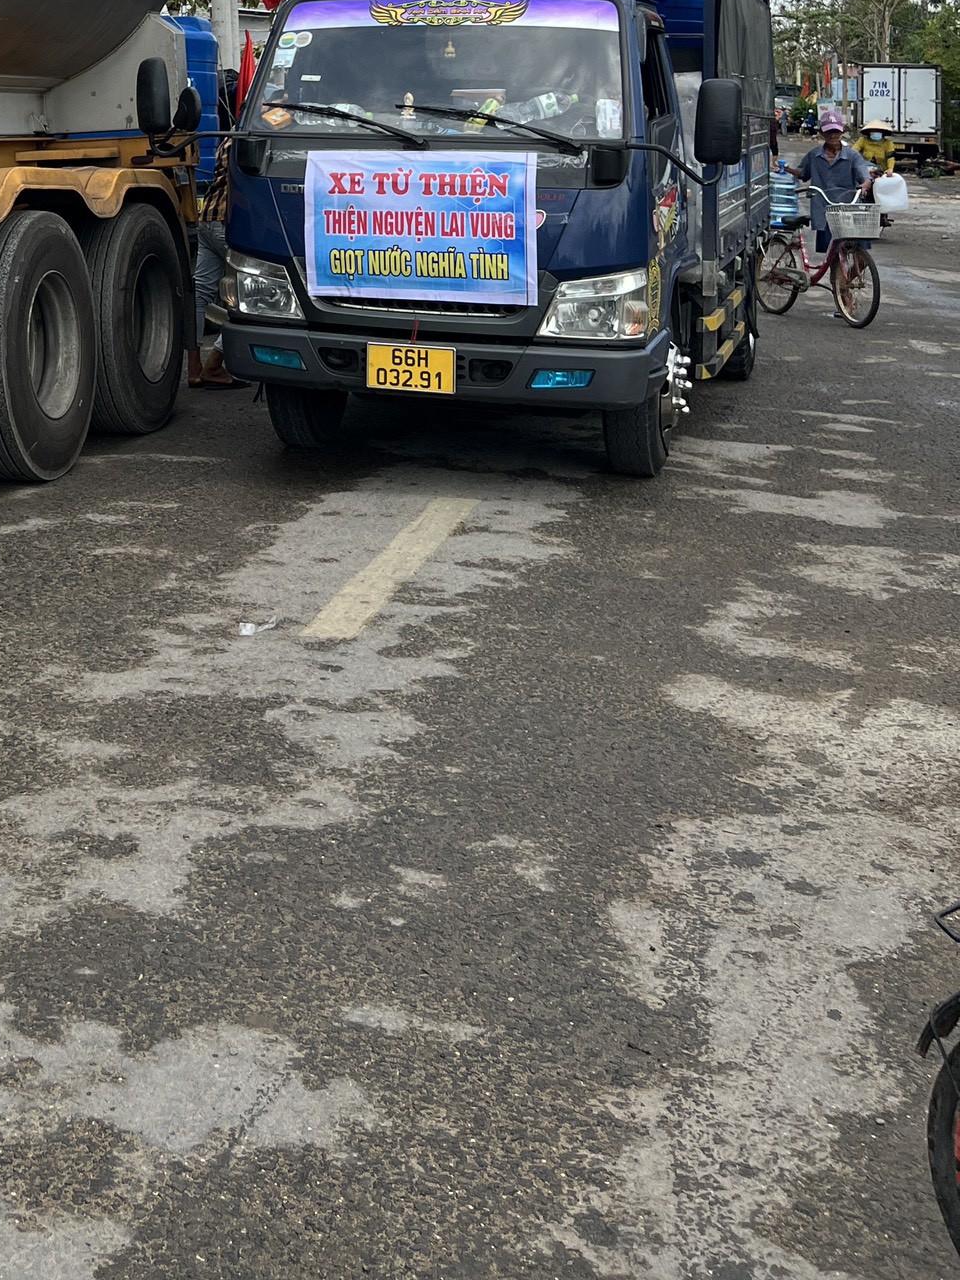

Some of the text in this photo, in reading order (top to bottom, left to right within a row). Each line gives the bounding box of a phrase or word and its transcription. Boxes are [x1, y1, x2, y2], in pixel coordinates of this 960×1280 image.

[869, 89, 890, 97] 0202
[872, 81, 888, 89] 71N
[328, 167, 510, 205] XE TỪ THIỆN
[324, 205, 516, 242] THIỆN NGUYỆN LAI VUNG
[330, 245, 509, 280] GIỌT NƯỚC NGHĨA TÌNH
[392, 348, 429, 368] 66H
[376, 367, 442, 390] 032.91
